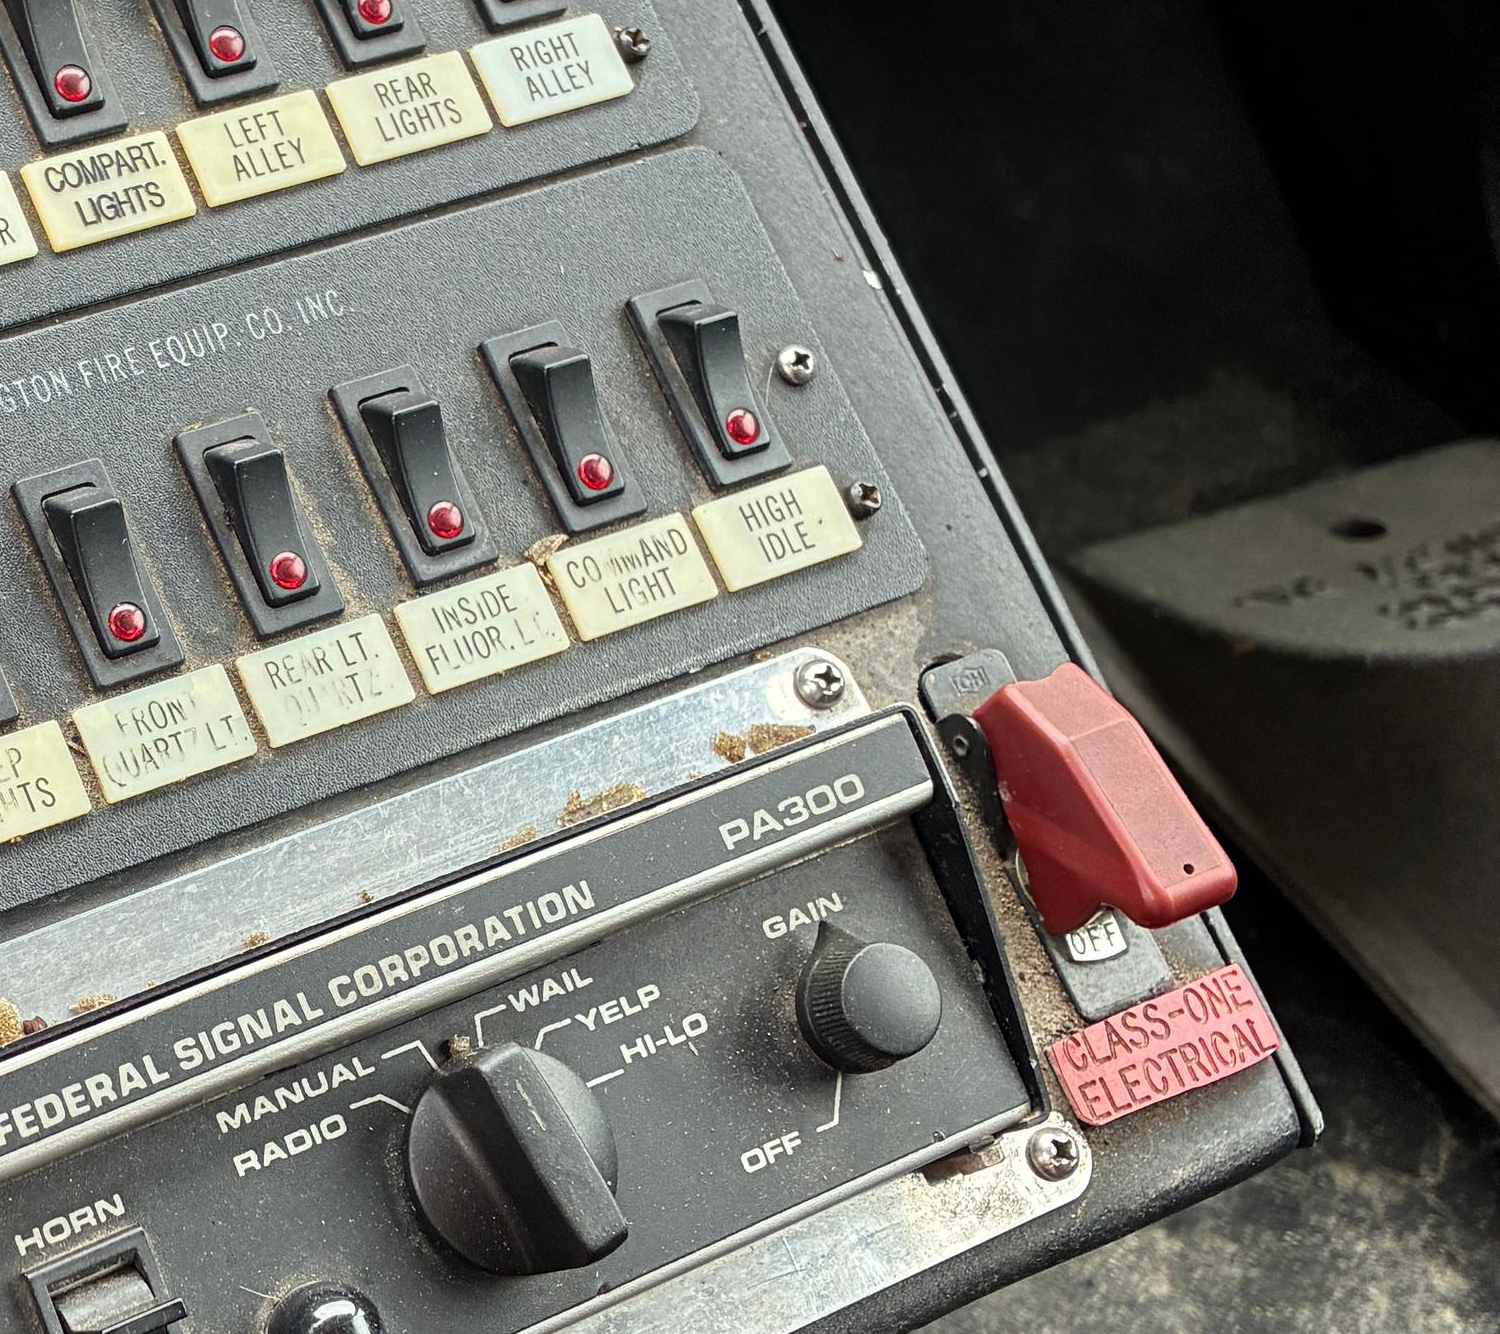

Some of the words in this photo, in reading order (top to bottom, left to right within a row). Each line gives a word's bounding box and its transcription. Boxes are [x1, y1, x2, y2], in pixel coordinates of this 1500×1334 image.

[509, 31, 582, 73] RIGHT
[373, 71, 439, 109] REAR
[524, 61, 596, 104] ALLEY
[222, 108, 286, 149] LEFT
[374, 97, 463, 143] LIGHTS
[43, 140, 168, 193] COMPART.
[231, 136, 307, 183] ALLEY
[74, 181, 167, 228] LIGHTS
[77, 346, 145, 389] FIRE
[148, 322, 242, 369] EQUIP.
[245, 307, 293, 341] CO.
[737, 487, 804, 533] HIGH
[756, 520, 817, 566] IDLE
[430, 583, 519, 635] INSIDE
[603, 567, 677, 615] LIGHT
[263, 645, 335, 691] REAR
[335, 631, 380, 667] LT.
[424, 625, 517, 677] FLUOR.
[717, 772, 866, 852] PA300
[761, 890, 845, 941] GAIN
[1070, 919, 1117, 957] OFF
[171, 990, 325, 1073] SIGNAL
[328, 880, 598, 1009] CORPORATION
[504, 968, 595, 1015] WAIL
[572, 983, 663, 1033] YELP
[1061, 969, 1255, 1073] CLASS-ONE
[618, 1011, 711, 1065] HI-LO
[1075, 1017, 1279, 1122] ELECTRICAL
[214, 1055, 377, 1135] MANUAL
[231, 1113, 349, 1178] RADIO
[739, 1130, 803, 1174] OFF
[13, 1192, 127, 1257] HORN
